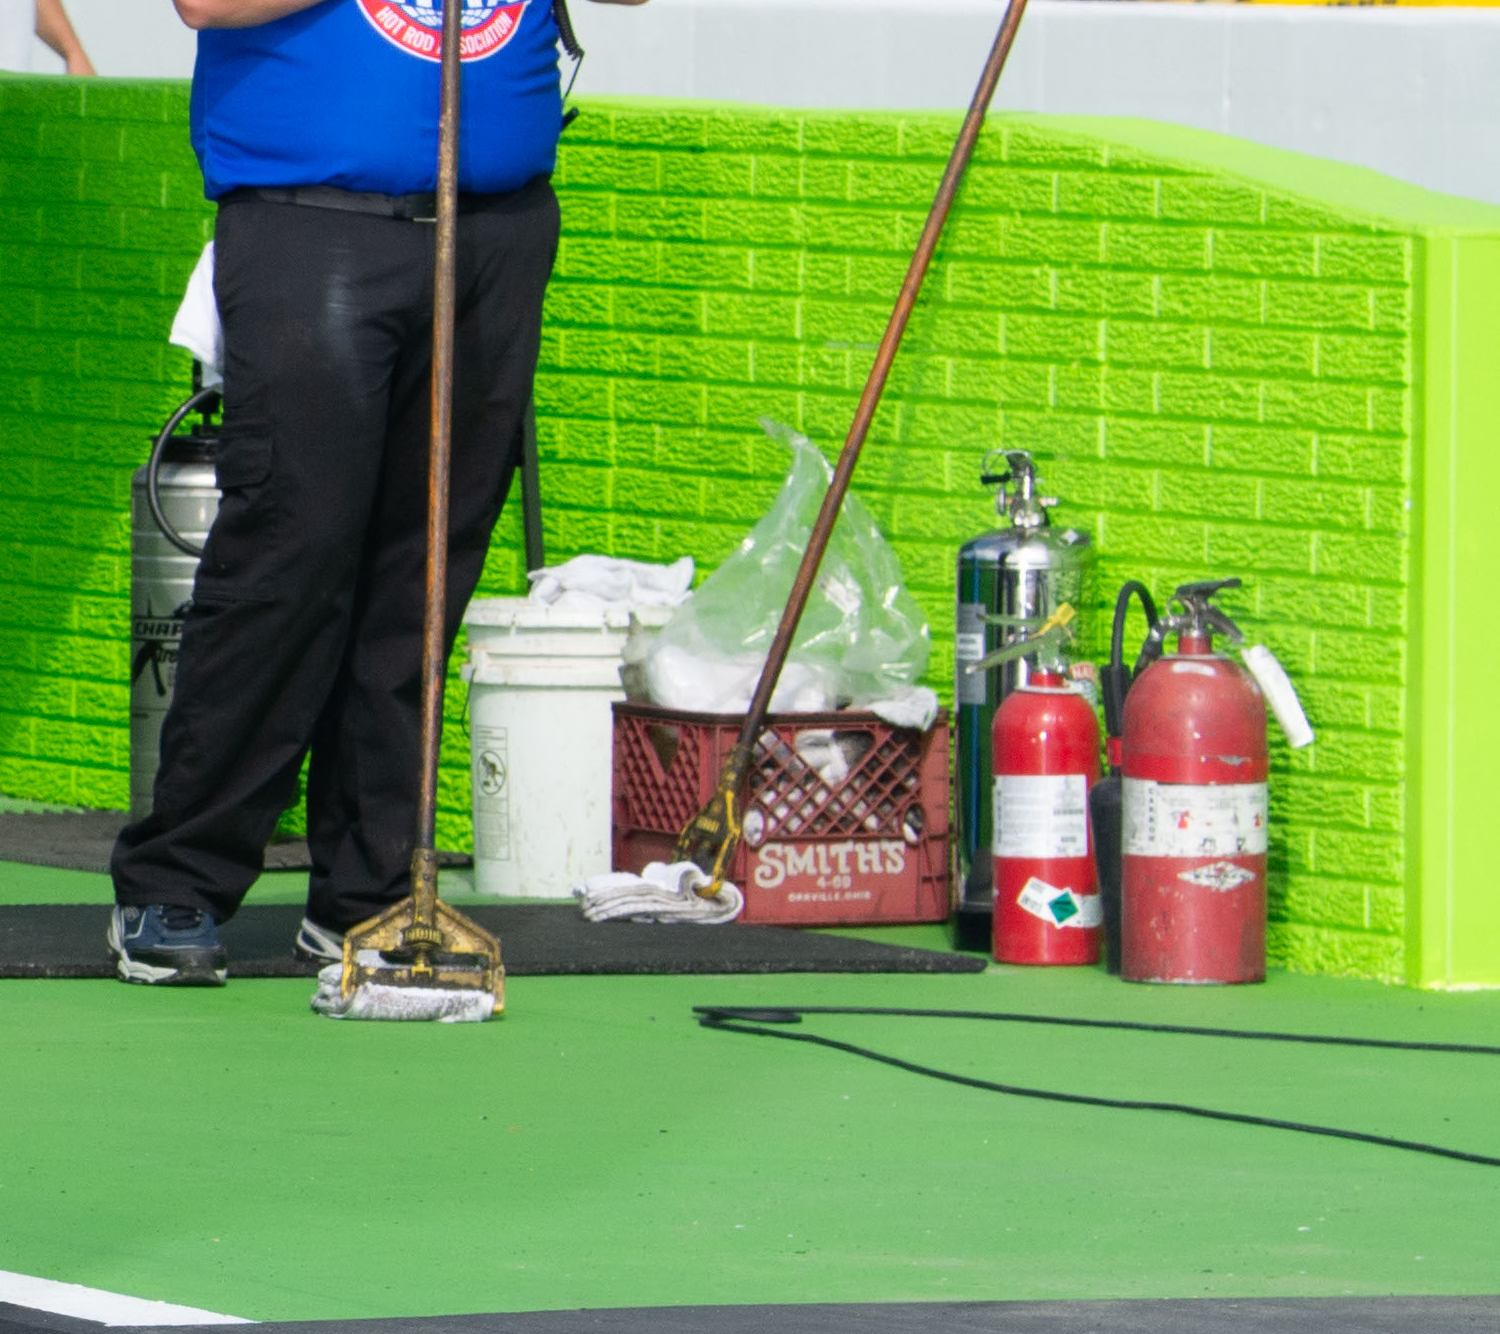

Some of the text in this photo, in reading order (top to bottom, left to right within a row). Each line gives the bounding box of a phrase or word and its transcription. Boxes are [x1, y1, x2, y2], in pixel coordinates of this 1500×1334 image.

[374, 4, 515, 56] HOT ROD SOCIATION
[133, 621, 181, 636] CHAP
[754, 840, 905, 889] SMITH'S
